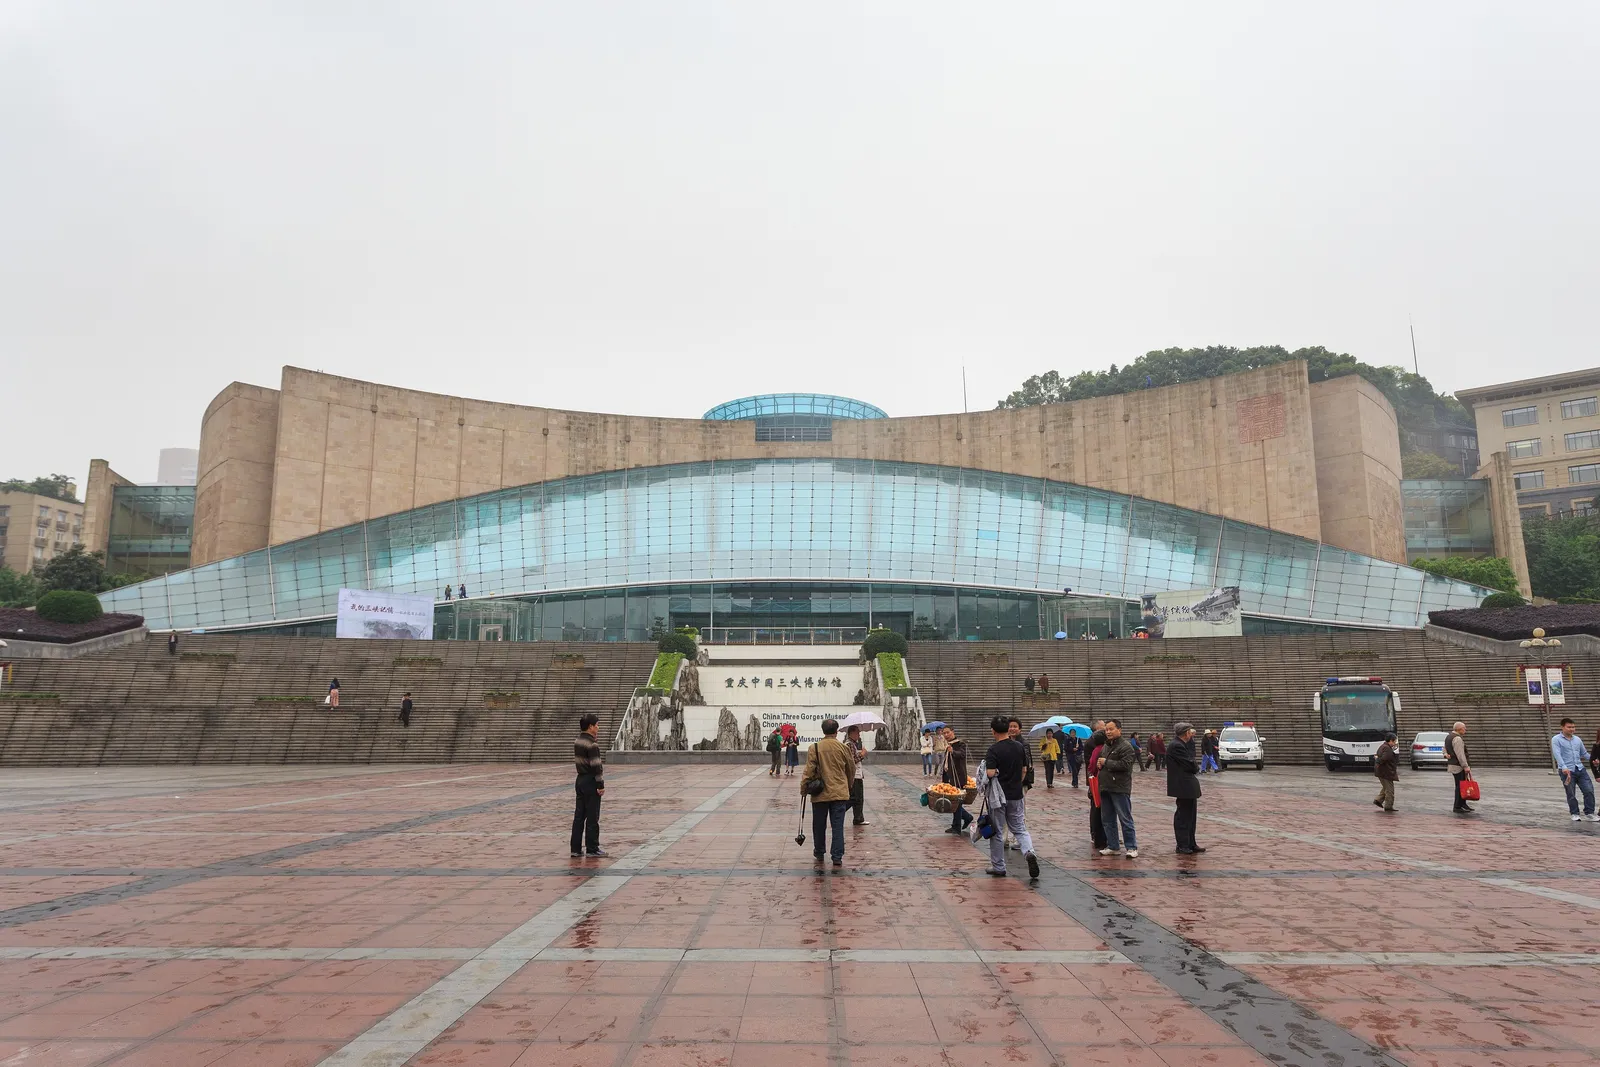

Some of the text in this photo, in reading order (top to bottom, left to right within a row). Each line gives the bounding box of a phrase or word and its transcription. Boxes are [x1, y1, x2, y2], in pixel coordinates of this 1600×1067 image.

[725, 676, 842, 688] 重庆中国三峡博物馆
[762, 712, 780, 720] China
[781, 712, 800, 720] Three
[800, 712, 824, 721] Gorges
